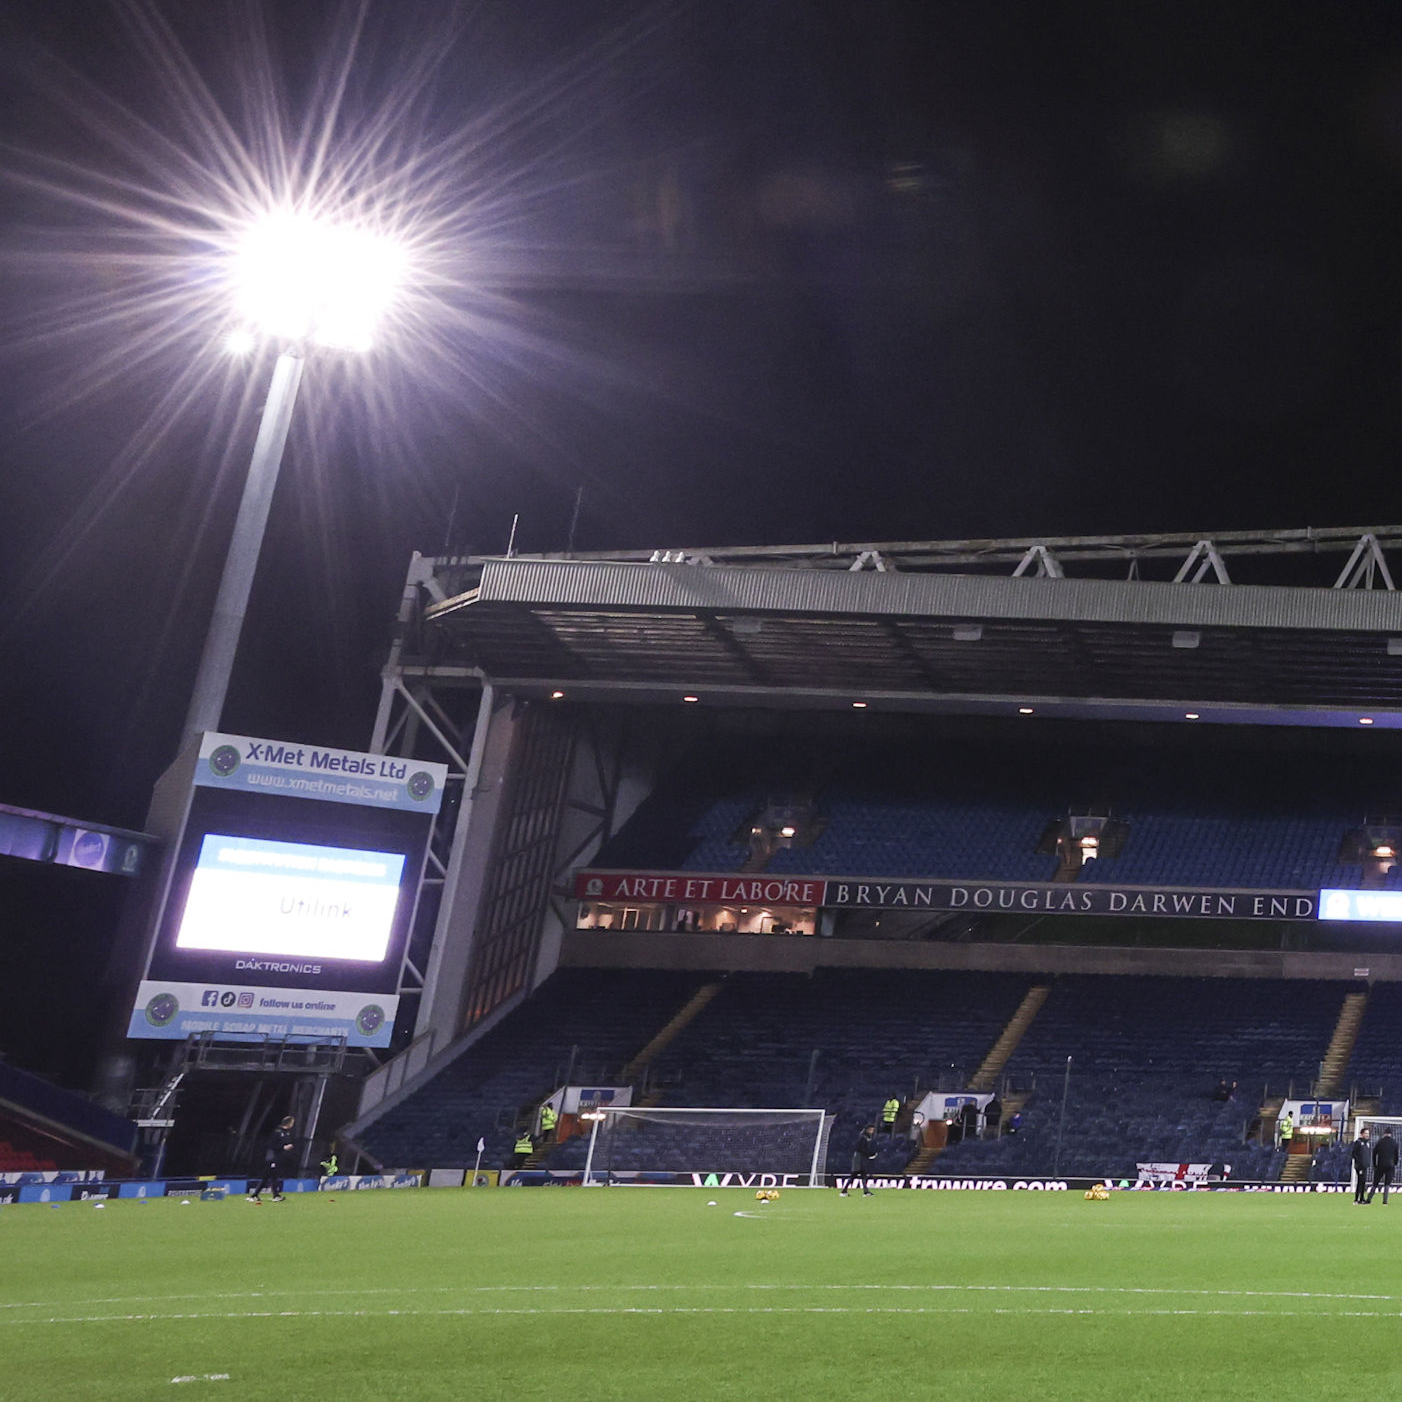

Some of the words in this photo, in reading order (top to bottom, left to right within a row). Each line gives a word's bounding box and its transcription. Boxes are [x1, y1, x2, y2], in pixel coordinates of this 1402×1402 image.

[245, 742, 305, 767] X-Met
[309, 750, 376, 776] Metals
[379, 761, 407, 780] Ltd
[248, 773, 399, 802] www.xmetmetals.net
[615, 878, 677, 898] ARTE
[684, 880, 715, 898] ET
[720, 879, 815, 902] LABORE
[836, 884, 933, 906] BRYAN
[950, 887, 1093, 911] DOUGLAS
[1109, 892, 1236, 915] DARWEN
[1253, 897, 1313, 917] END
[235, 959, 322, 975] DAKTRONICS
[259, 997, 290, 1010] follow
[291, 1001, 304, 1010] us
[305, 1000, 336, 1011] online
